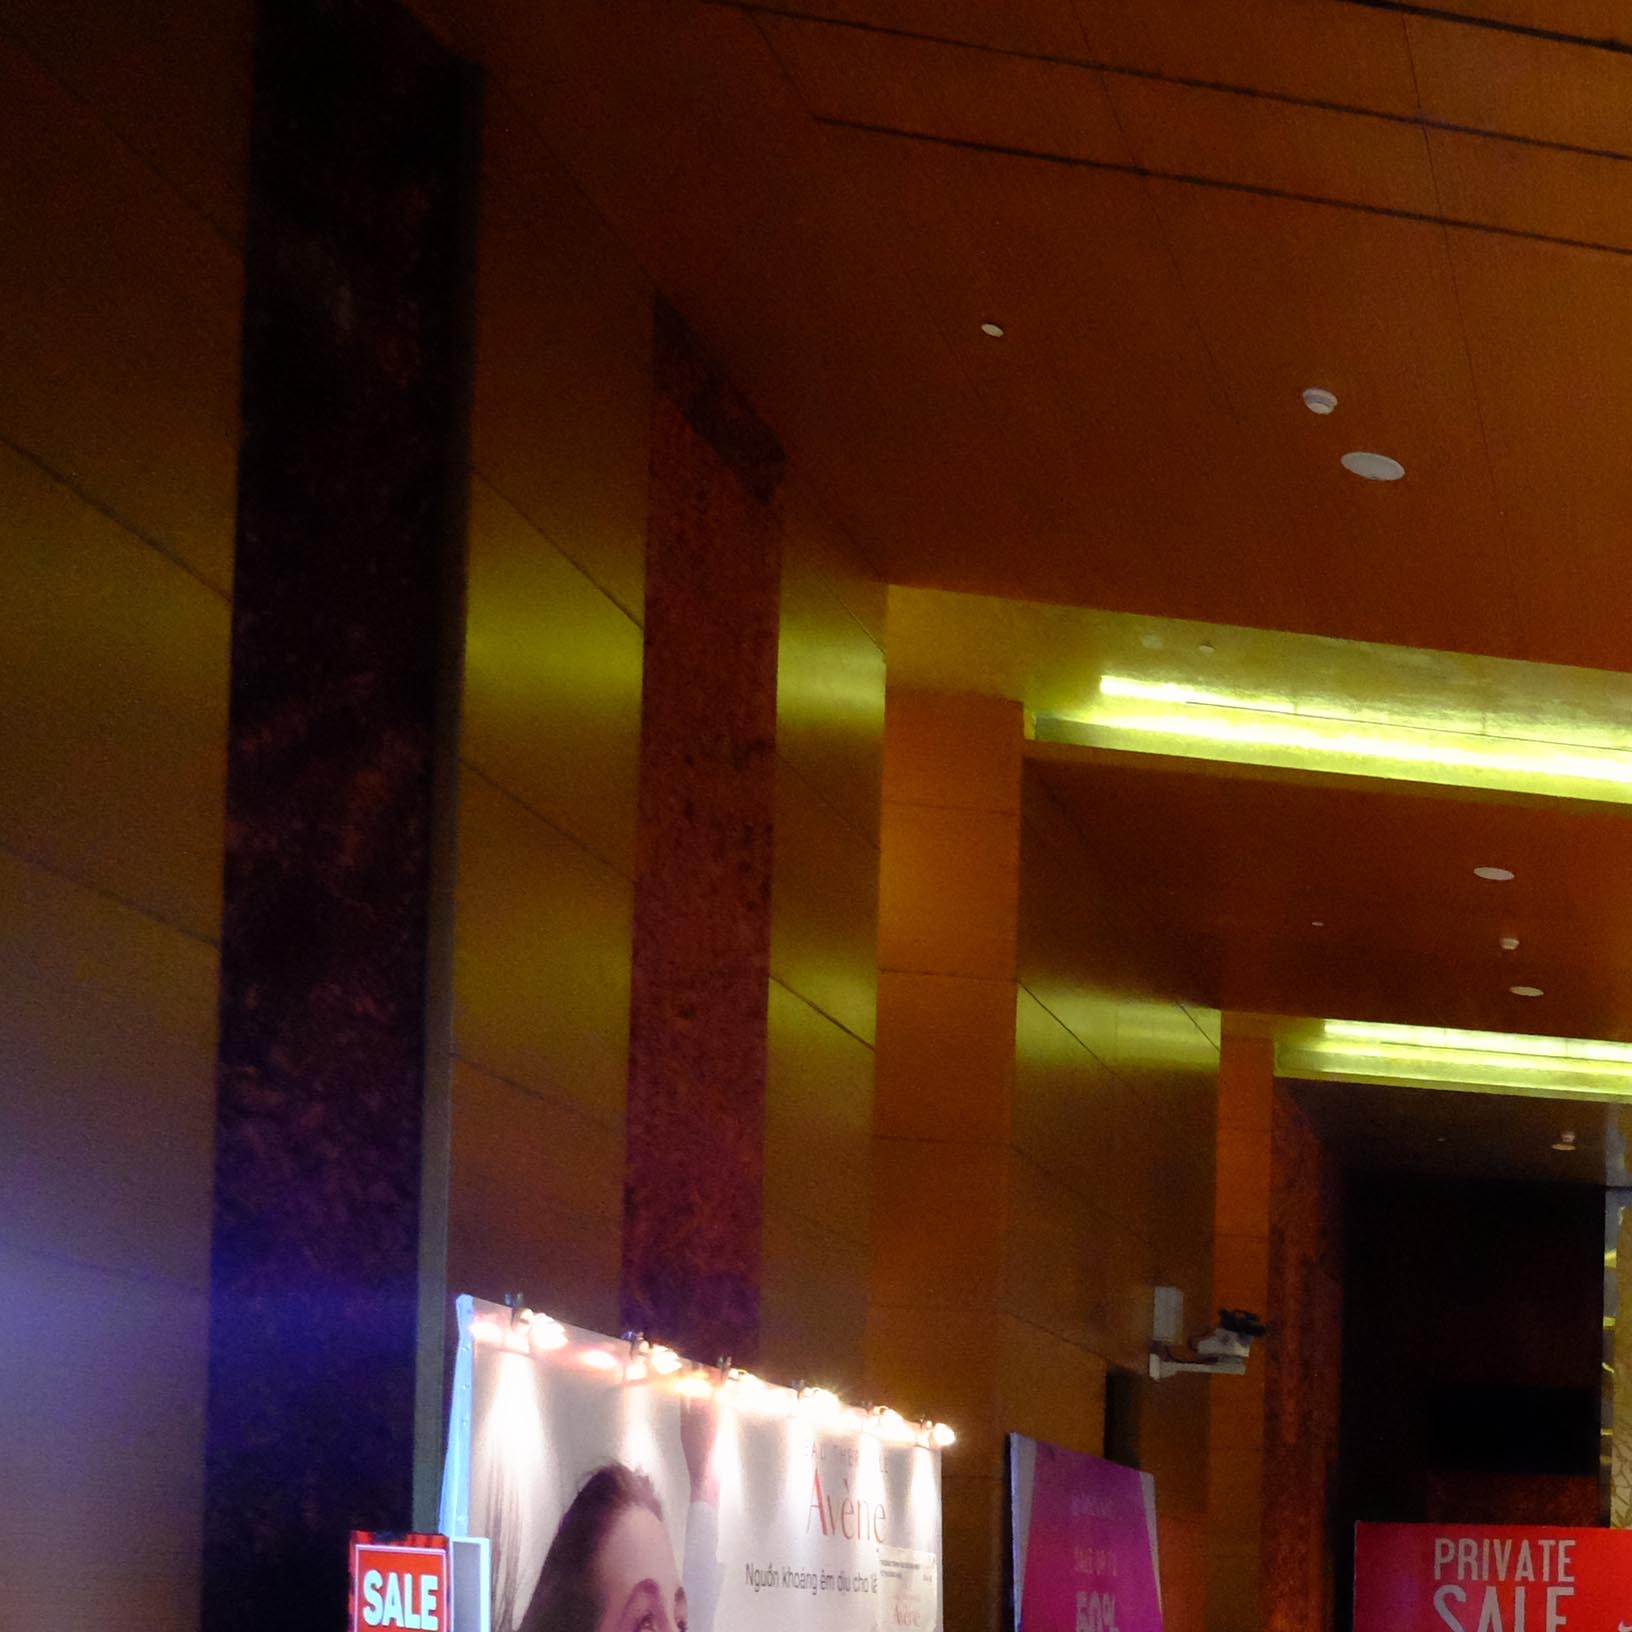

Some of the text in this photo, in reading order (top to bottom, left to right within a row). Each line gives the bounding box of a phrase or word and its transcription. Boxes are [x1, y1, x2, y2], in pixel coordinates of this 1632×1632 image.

[806, 1467, 886, 1544] Avène
[1434, 1537, 1577, 1583] PRIVATE
[362, 1569, 440, 1632] SALE
